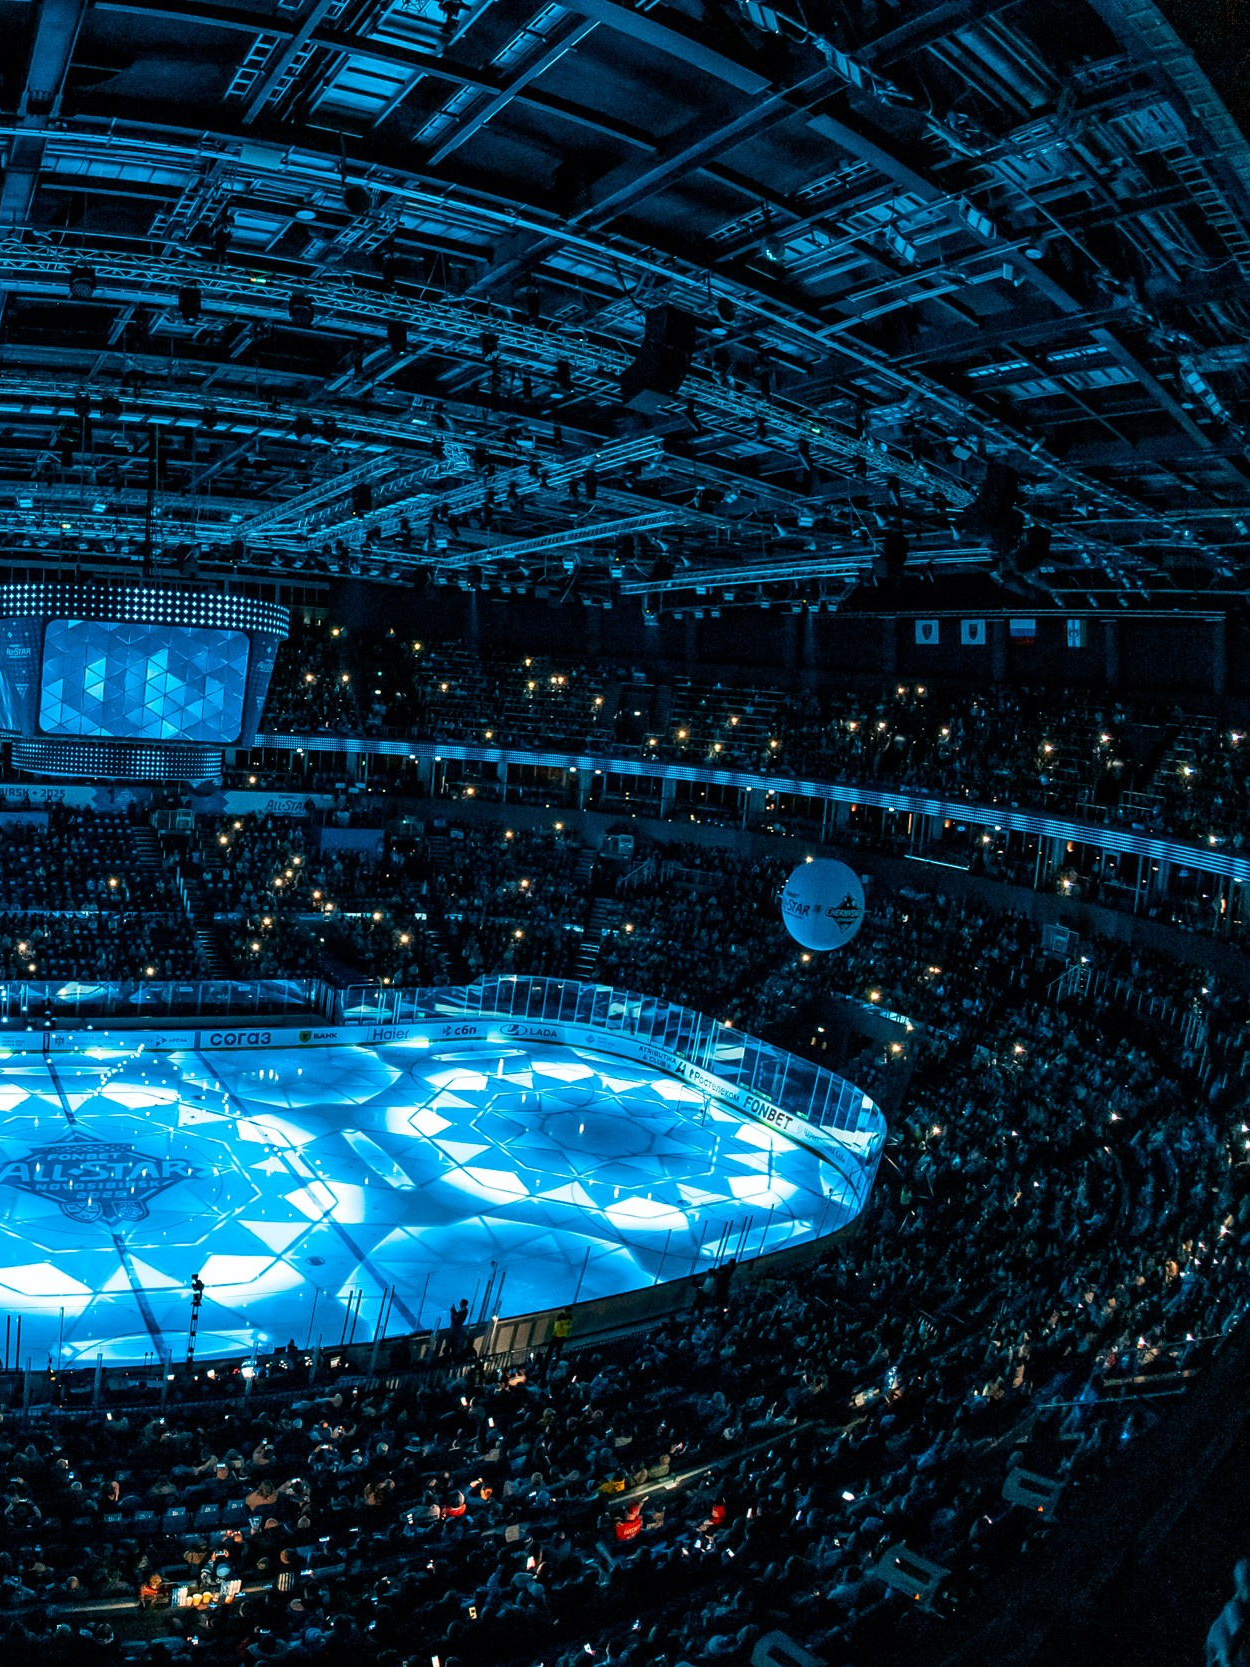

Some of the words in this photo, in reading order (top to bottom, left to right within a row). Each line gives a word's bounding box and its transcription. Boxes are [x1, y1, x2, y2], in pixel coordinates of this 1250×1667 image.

[40, 788, 66, 799] 2025
[313, 1031, 338, 1039] БАНК
[372, 1027, 409, 1041] Haier
[529, 1028, 558, 1038] LADA
[638, 1046, 677, 1065] ATRIBUTIKA
[694, 1071, 740, 1104] Ростелеком
[743, 1095, 793, 1130] FONBET
[46, 1152, 121, 1161] FONBET
[35, 1180, 161, 1191] NOVOSIBIRSK
